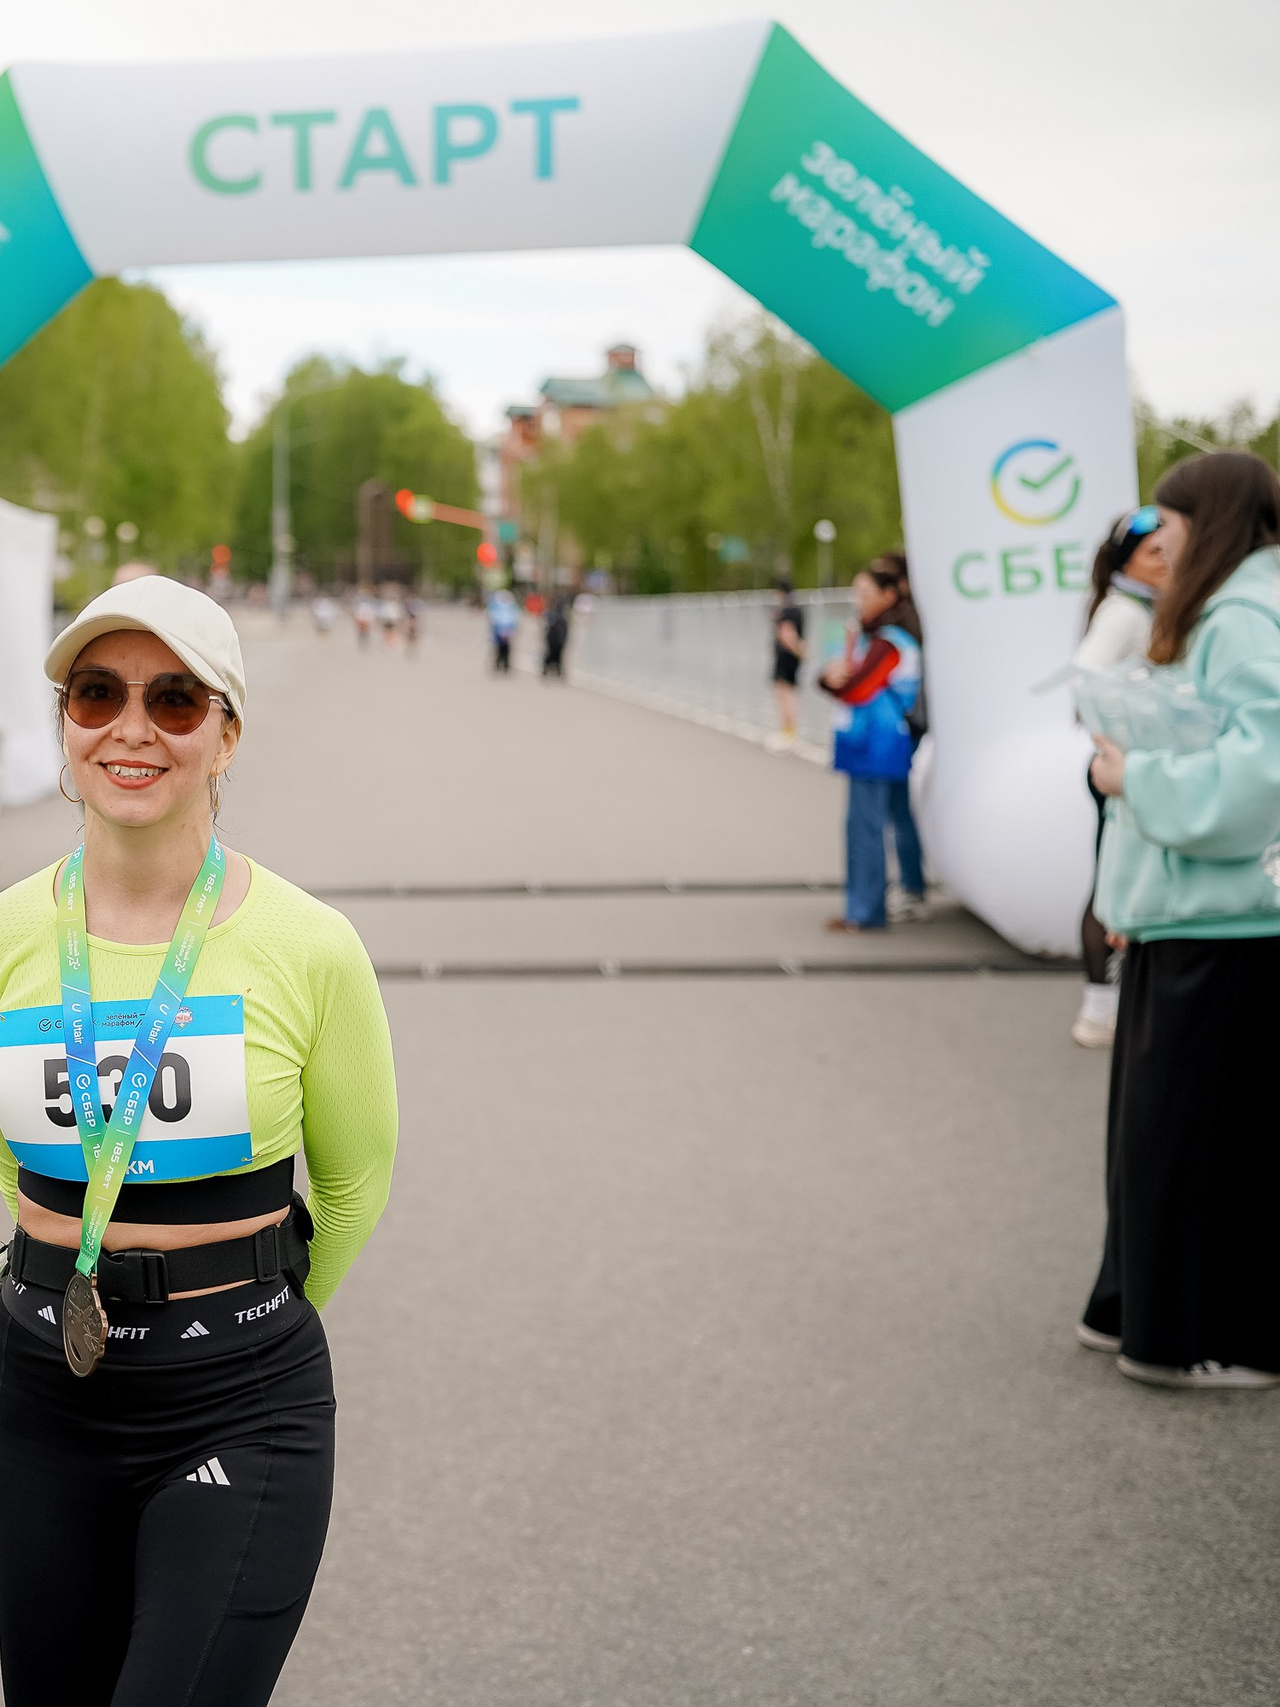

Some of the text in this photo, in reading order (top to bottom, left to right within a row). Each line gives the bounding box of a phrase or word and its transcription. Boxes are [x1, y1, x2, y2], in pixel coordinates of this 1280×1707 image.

[188, 95, 581, 197] СТАРТ
[800, 140, 992, 295] зелёный
[770, 172, 956, 329] марафон
[951, 541, 1089, 602] СБЕ
[204, 873, 217, 893] 185
[195, 894, 207, 915] лет
[72, 1018, 83, 1045] Utair
[101, 1019, 135, 1028] марафон
[147, 1019, 165, 1045] Utair
[81, 1092, 101, 1163] СБЕР 18
[102, 1090, 140, 1190] СБЕР 185 лет
[234, 1286, 291, 1324] TECHFIT
[107, 1326, 150, 1340] HFIT
